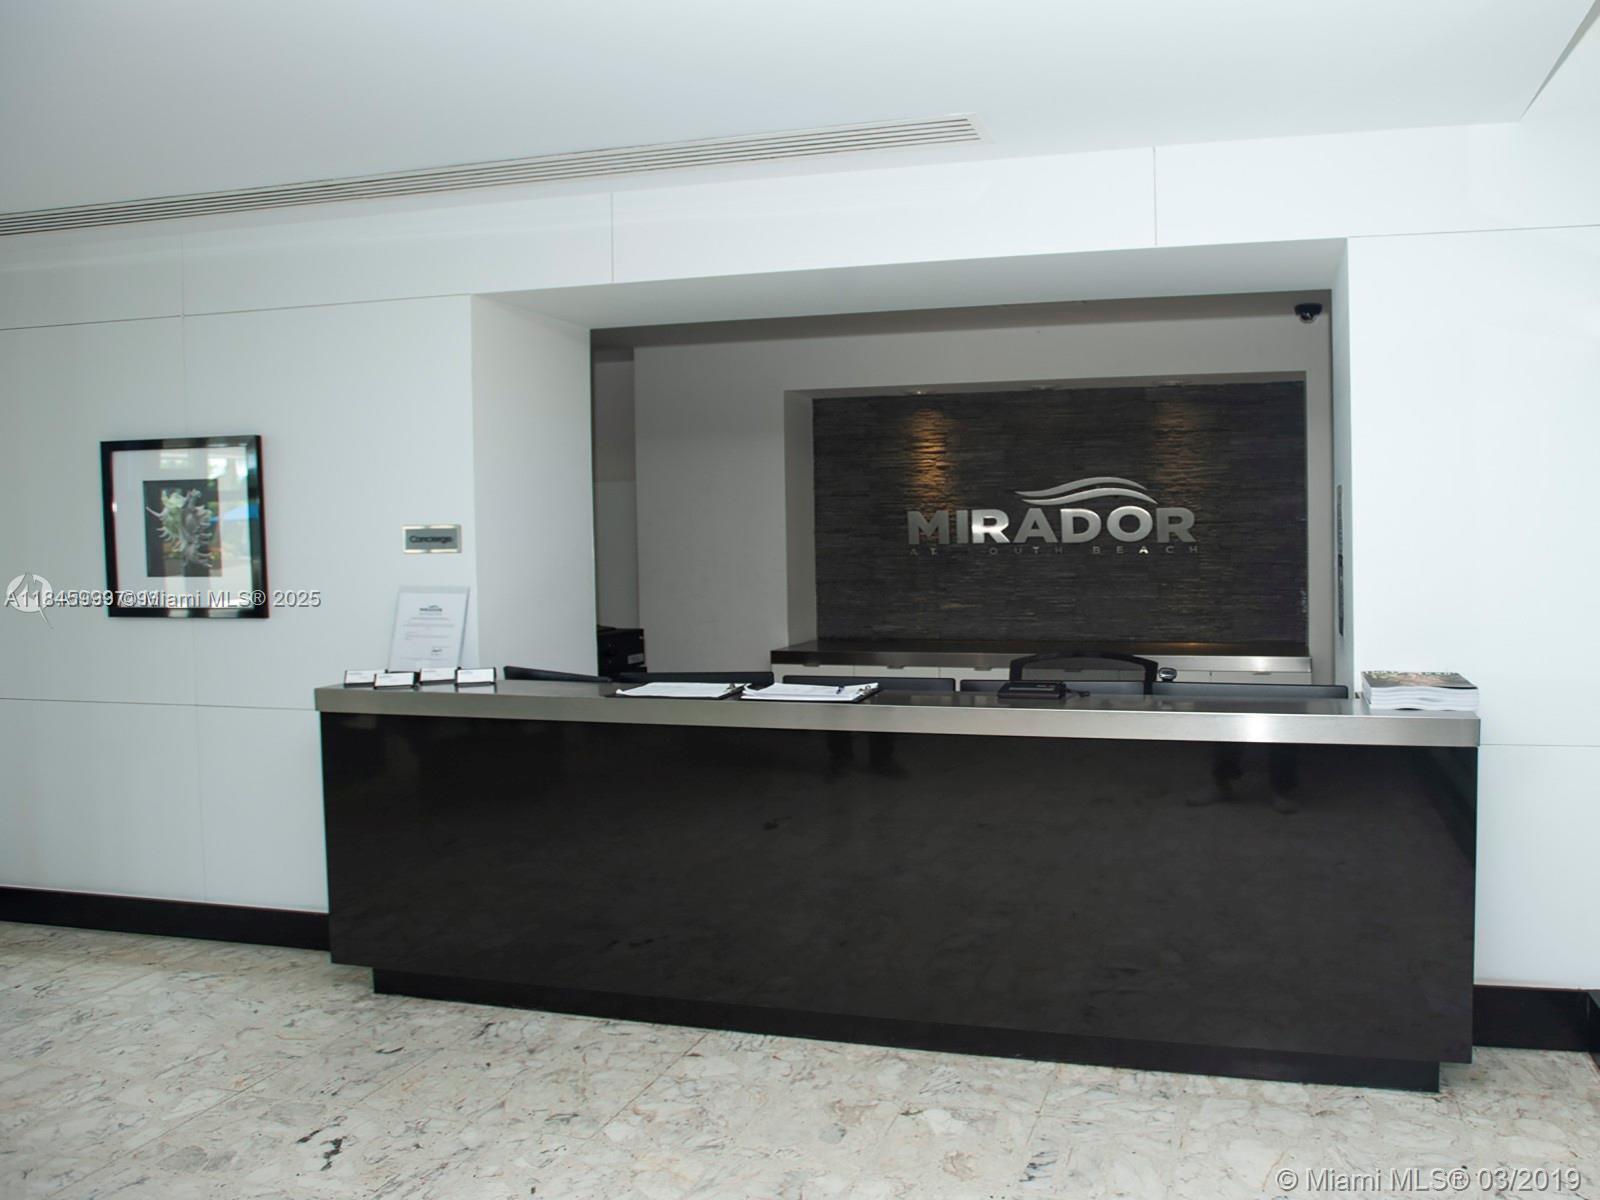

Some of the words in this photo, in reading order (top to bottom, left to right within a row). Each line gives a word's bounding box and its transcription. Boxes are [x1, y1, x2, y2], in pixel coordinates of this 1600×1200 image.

[906, 505, 1196, 544] MIRADOR
[965, 545, 1064, 555] OUTH
[1091, 544, 1199, 555] BEACH
